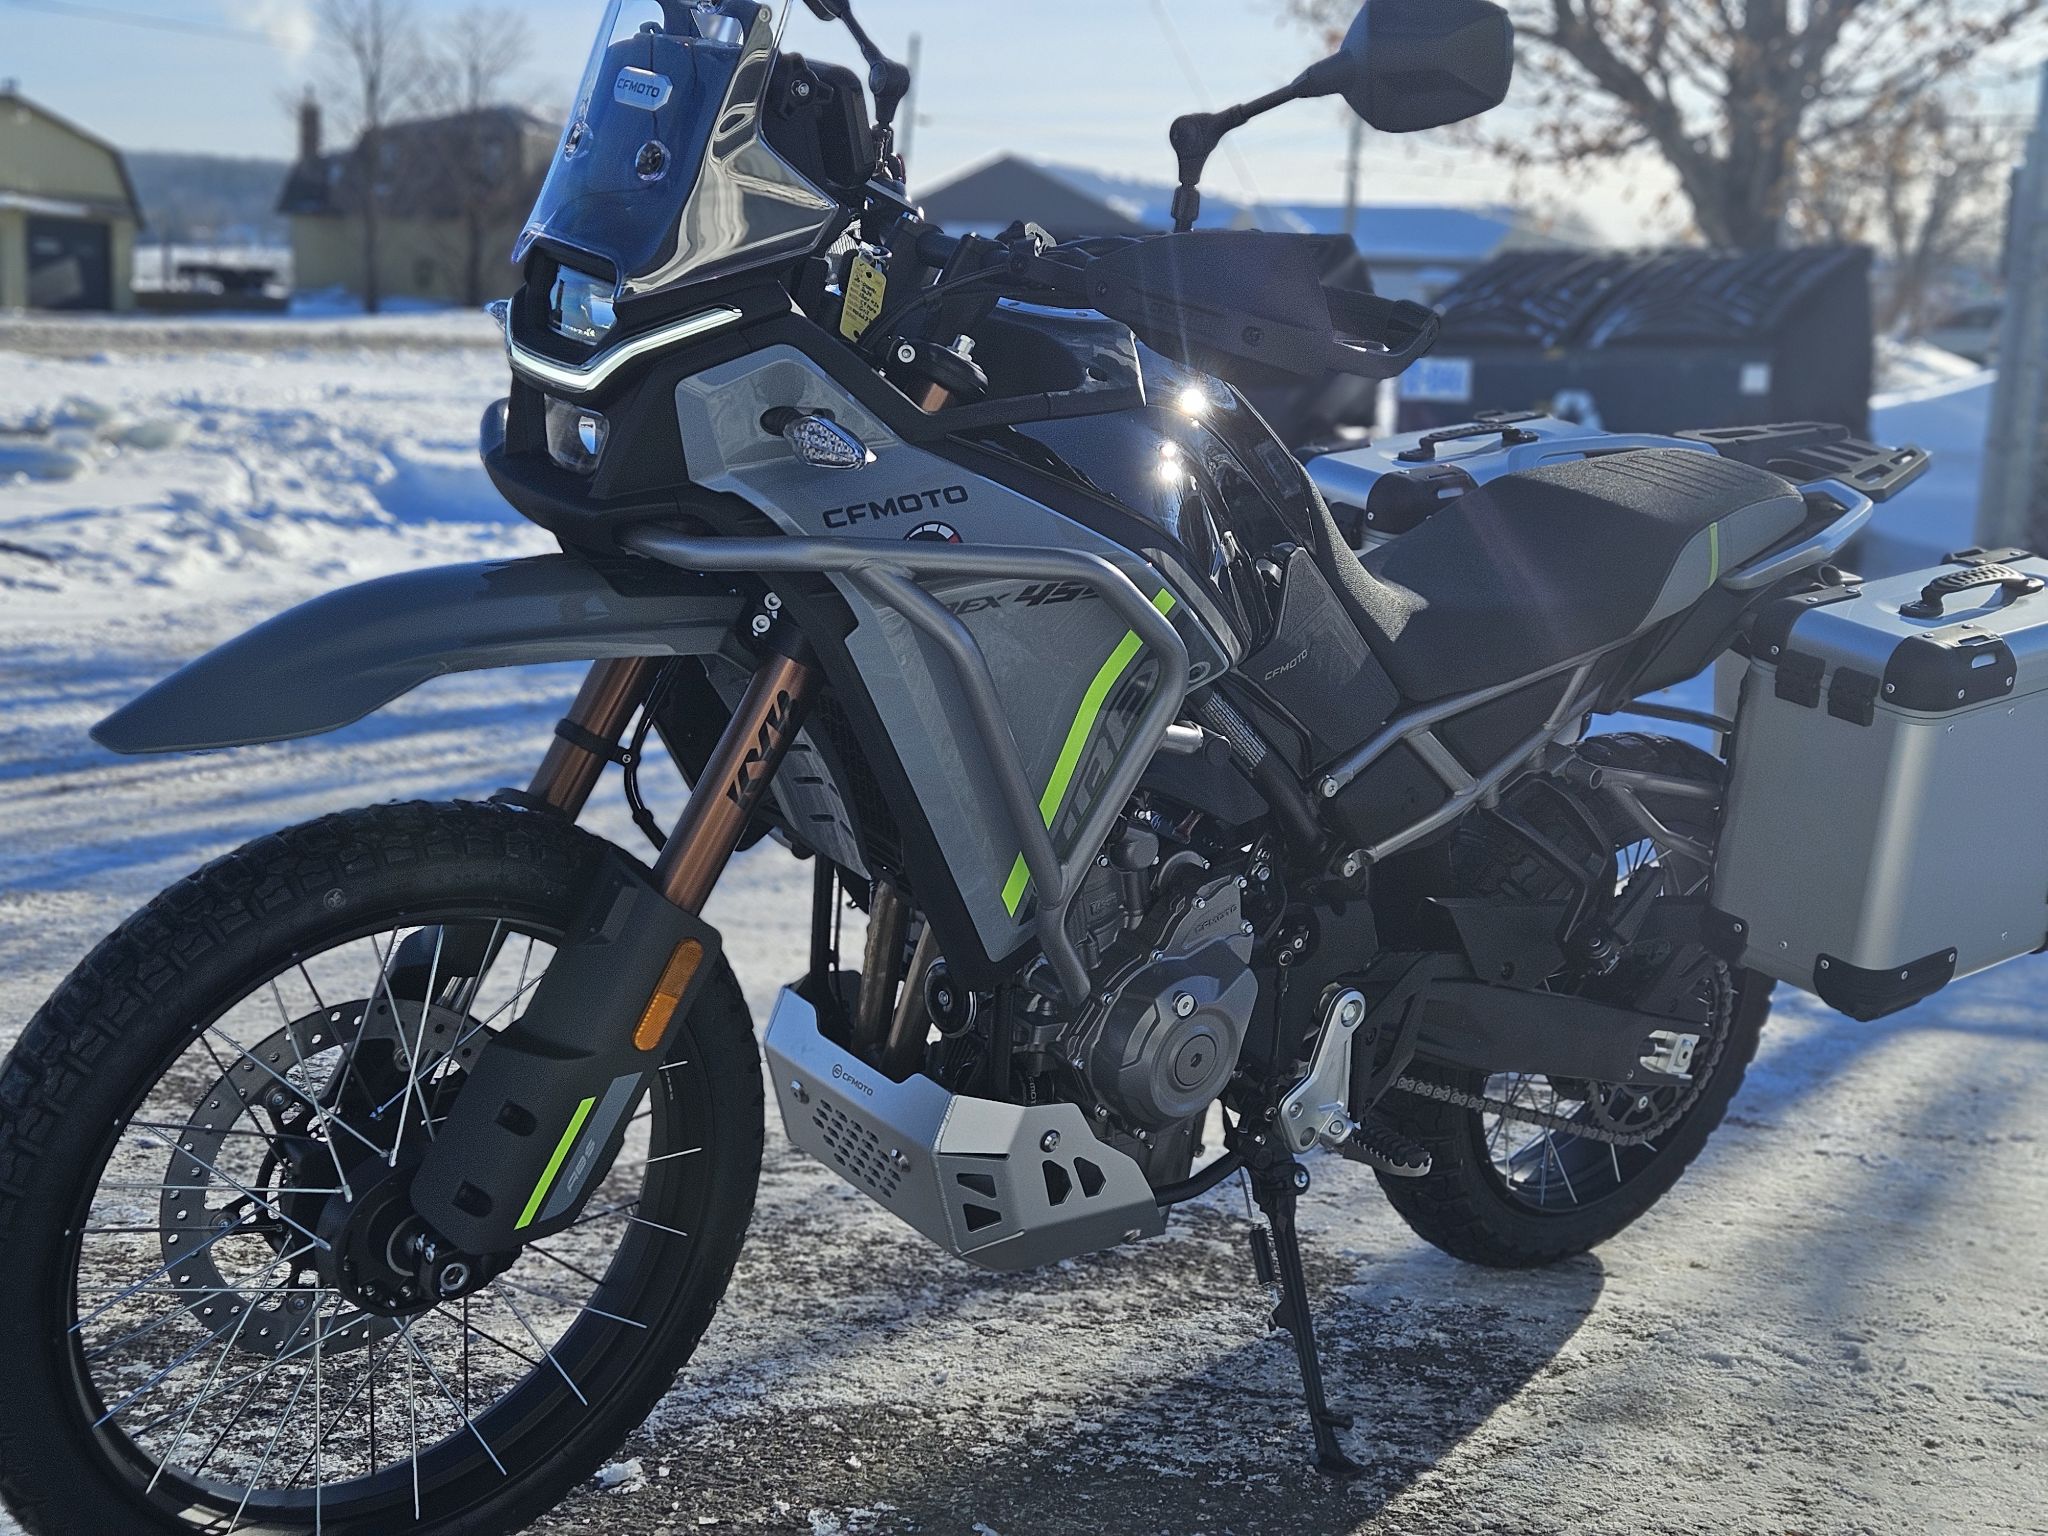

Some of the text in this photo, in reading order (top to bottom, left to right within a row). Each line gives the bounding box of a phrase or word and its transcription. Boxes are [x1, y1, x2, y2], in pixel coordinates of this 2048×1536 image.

[616, 78, 660, 98] CFMOTO
[822, 485, 969, 528] CFMOTO
[1264, 649, 1308, 681] CFMOTO
[842, 1072, 874, 1097] CFMOTO
[566, 1137, 596, 1193] ABS
